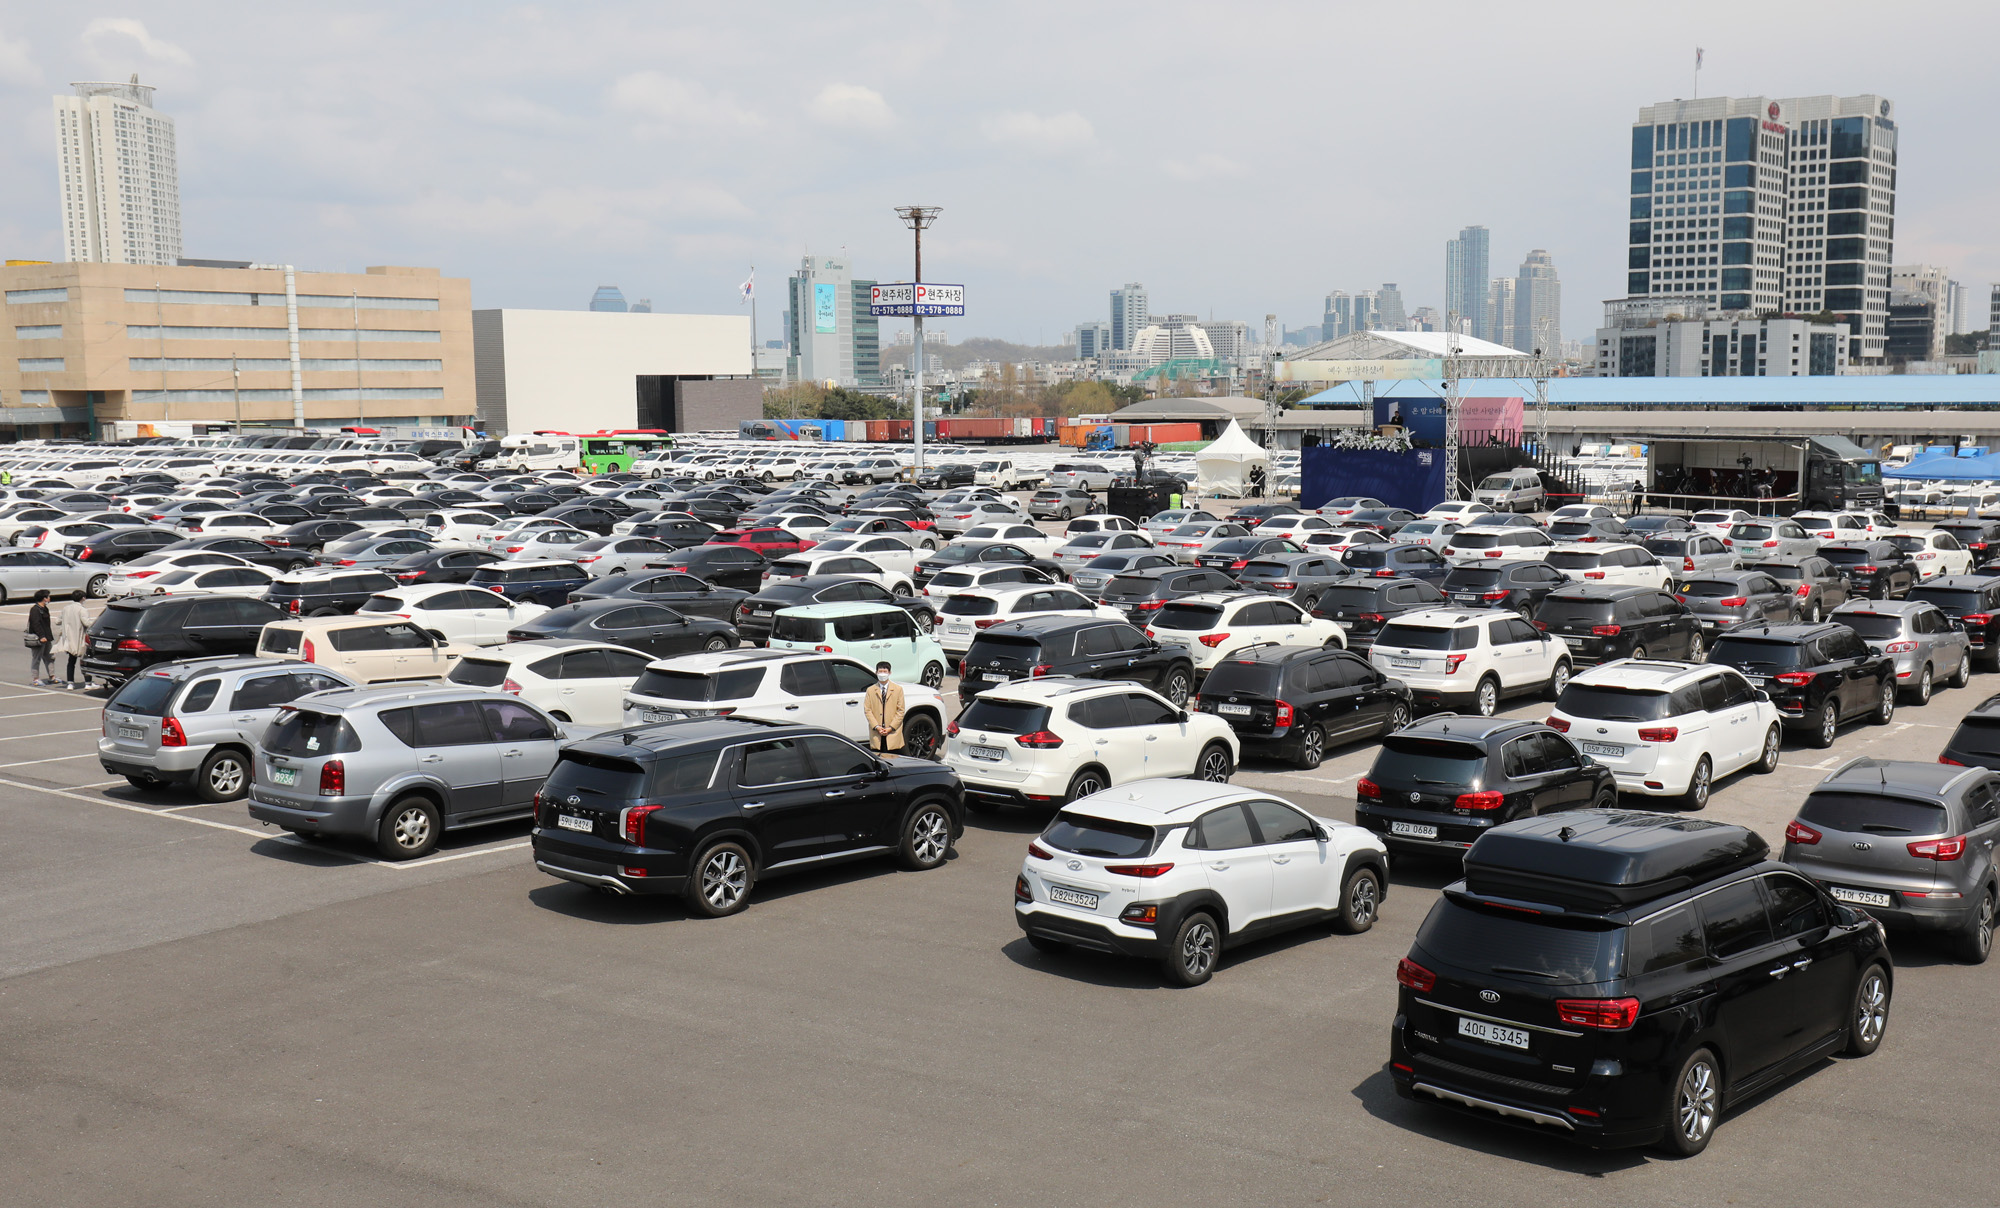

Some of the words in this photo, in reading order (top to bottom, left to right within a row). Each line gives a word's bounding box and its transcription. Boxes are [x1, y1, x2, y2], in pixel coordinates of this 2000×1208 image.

[872, 288, 880, 303] P
[881, 288, 912, 302] 현주차장
[917, 286, 926, 302] P
[928, 288, 962, 302] 현주차장
[871, 306, 913, 315] 02-578-0888
[916, 305, 963, 315] 02-578-0888
[274, 772, 294, 784] 8936
[1413, 824, 1433, 835] 0686
[1073, 894, 1094, 906] 3524
[1858, 893, 1884, 905] 9543
[1481, 991, 1499, 1002] KIA
[1492, 1027, 1523, 1045] 5345
